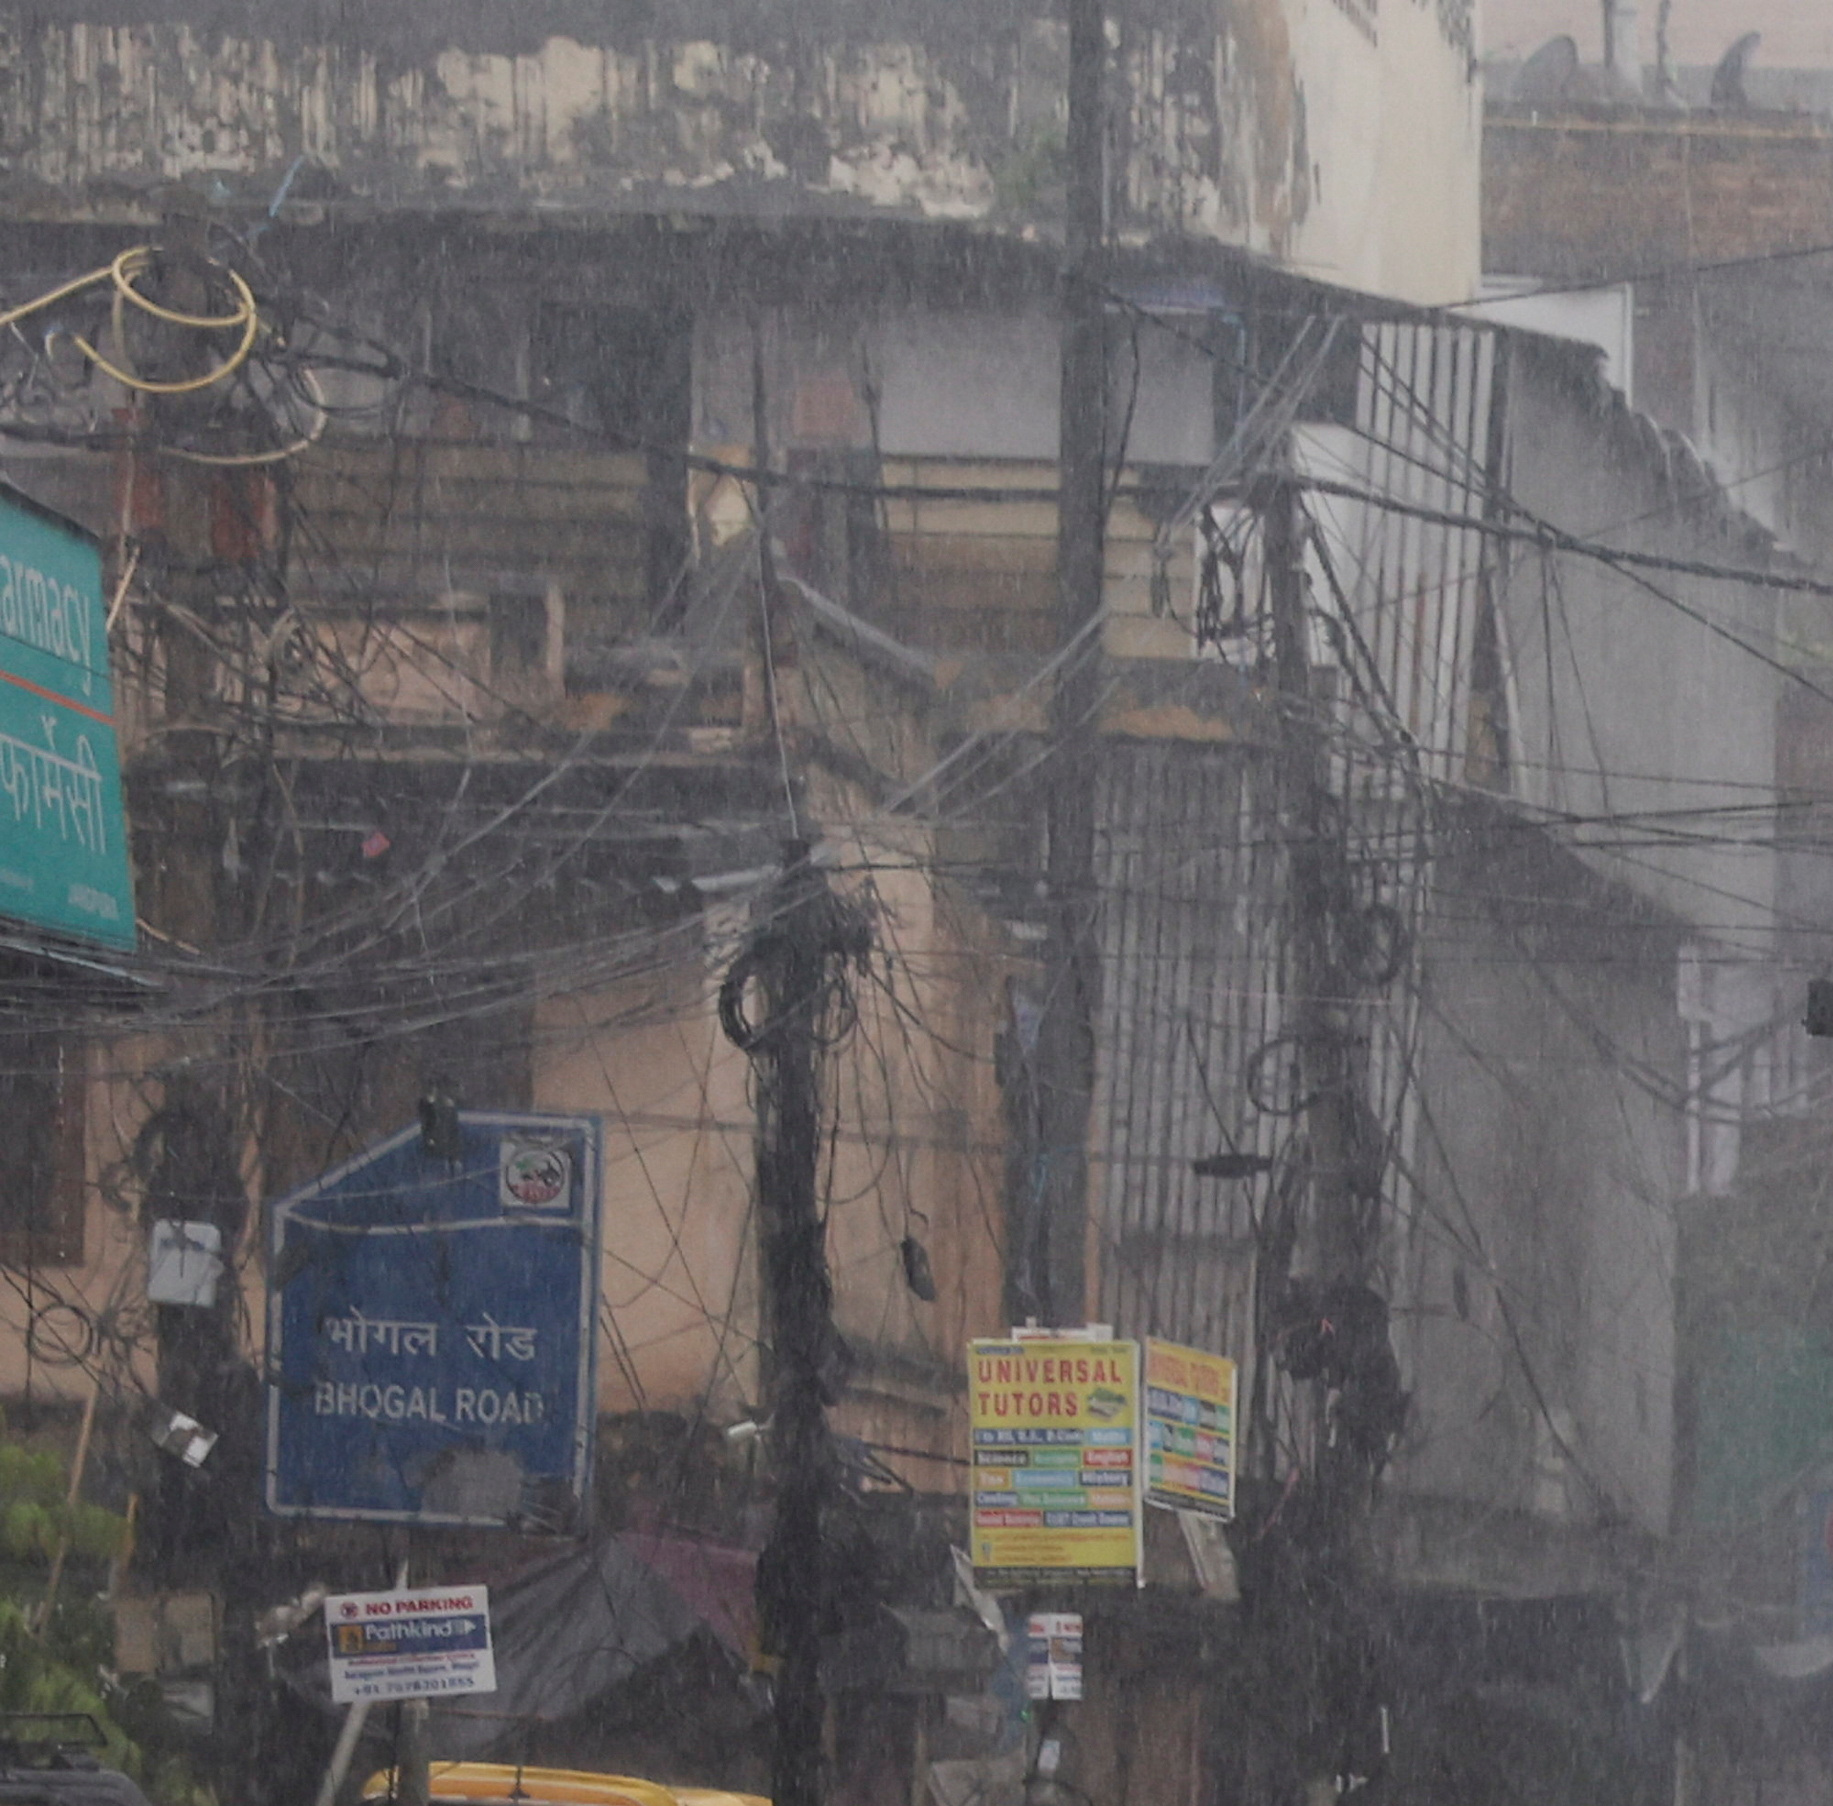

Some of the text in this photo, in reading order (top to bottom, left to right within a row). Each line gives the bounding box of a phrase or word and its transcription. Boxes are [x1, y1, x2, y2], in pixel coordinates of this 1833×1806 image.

[324, 1304, 538, 1361] भोगल रोड
[978, 1359, 1122, 1384] UNIVERSAL
[314, 1381, 544, 1424] BHOGAL ROAD
[978, 1392, 1078, 1417] TUTORS
[366, 1596, 474, 1615] NO PARKING
[365, 1619, 451, 1640] Pathkind
